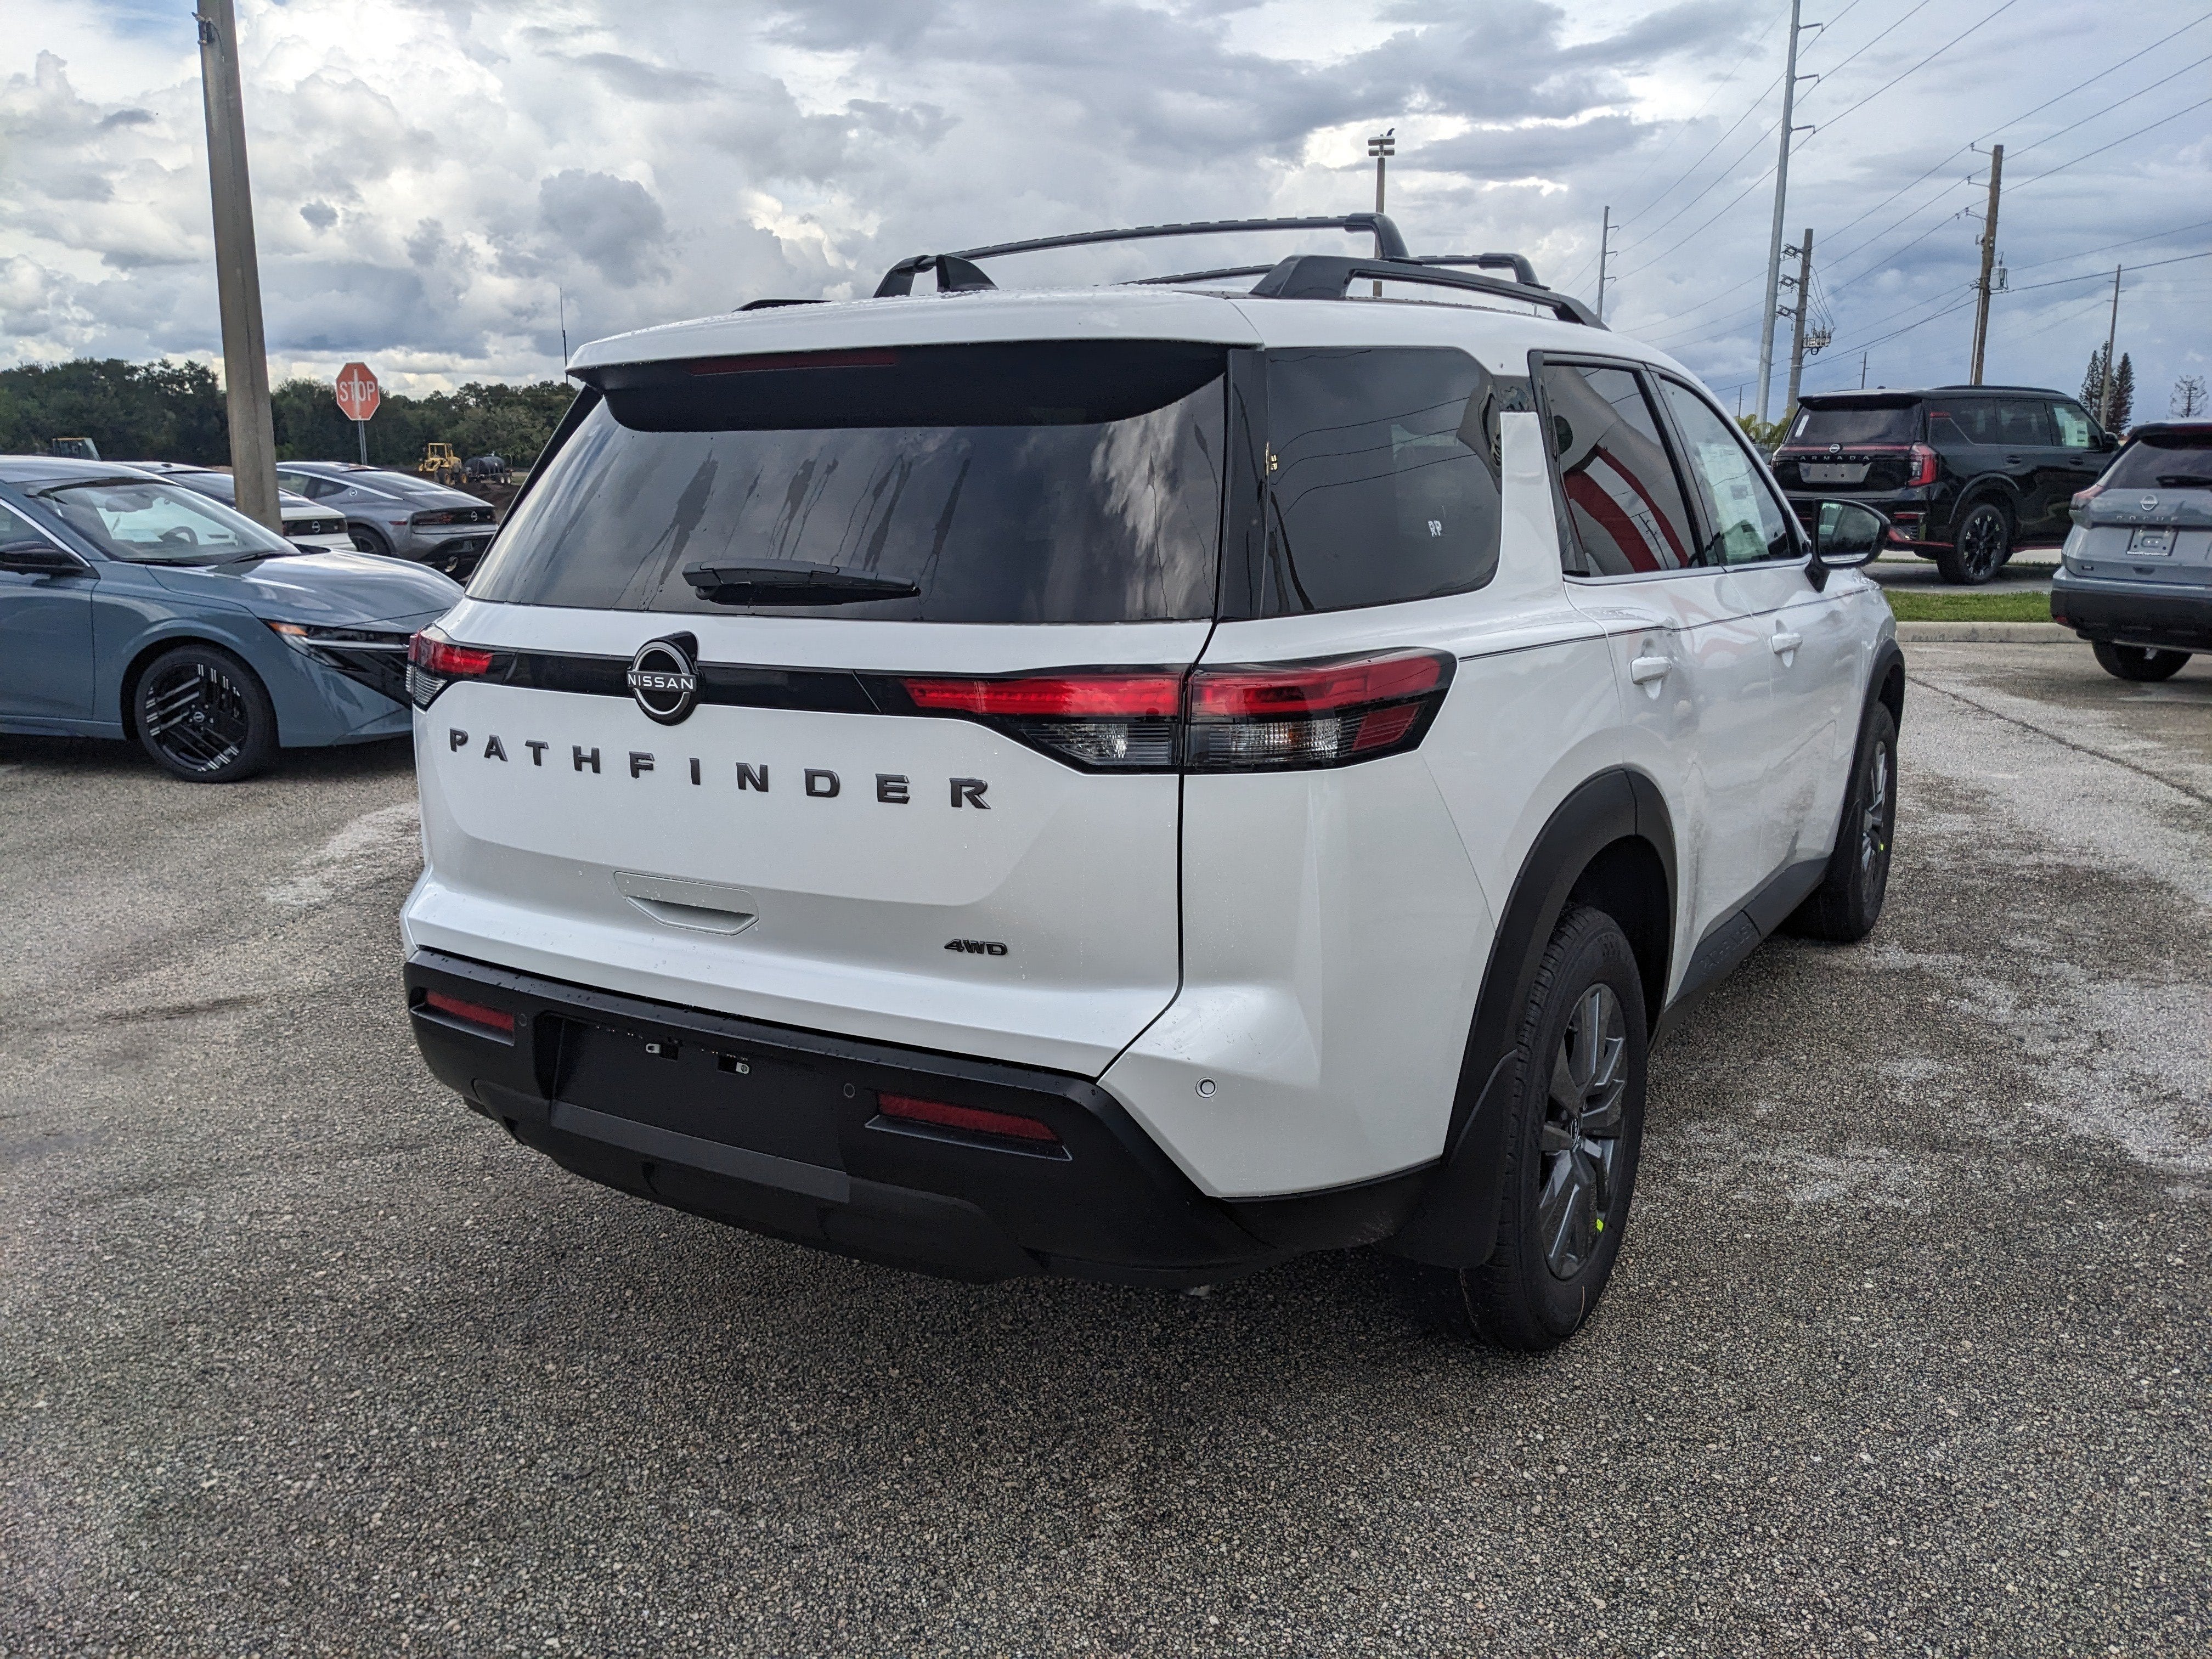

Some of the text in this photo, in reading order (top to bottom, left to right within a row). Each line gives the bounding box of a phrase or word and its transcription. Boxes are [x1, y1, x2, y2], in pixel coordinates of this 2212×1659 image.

[340, 381, 376, 402] STOP
[628, 673, 694, 690] NISSAN
[449, 727, 991, 810] PATHFINDER
[944, 938, 1008, 956] 4WD
